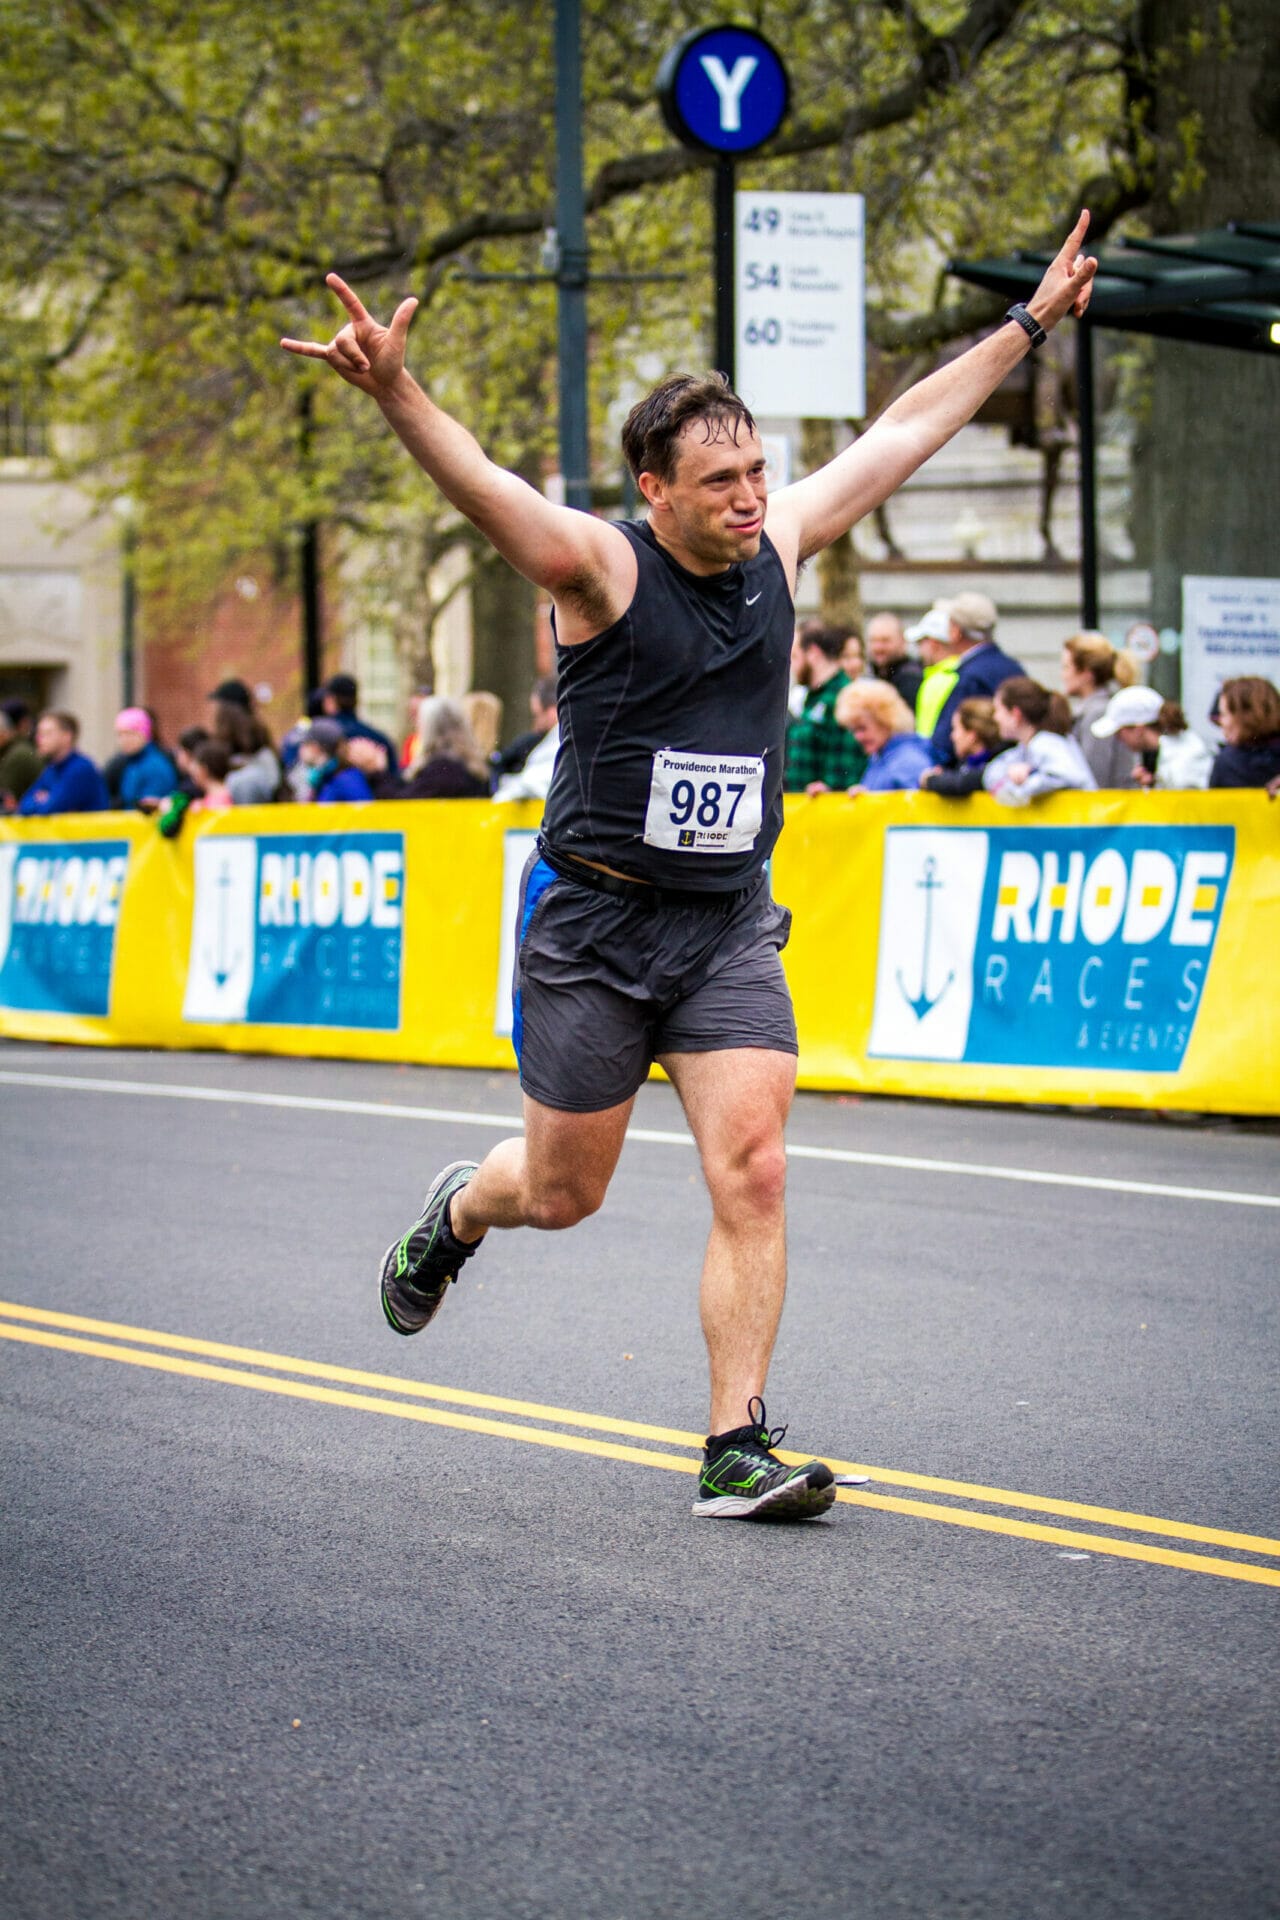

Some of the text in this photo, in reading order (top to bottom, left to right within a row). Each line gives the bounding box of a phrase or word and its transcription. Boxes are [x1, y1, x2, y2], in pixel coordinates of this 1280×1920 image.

[699, 55, 759, 132] Y
[744, 207, 781, 236] 49
[744, 263, 781, 291] 54
[744, 319, 781, 346] 60
[663, 759, 758, 775] Providence Marathon
[669, 779, 747, 828] 987
[15, 856, 127, 928] RHODE
[259, 851, 403, 928] RHODE
[992, 848, 1228, 946] RHODE
[984, 953, 1203, 1013] RACES
[1101, 1023, 1189, 1053] EVENTS
